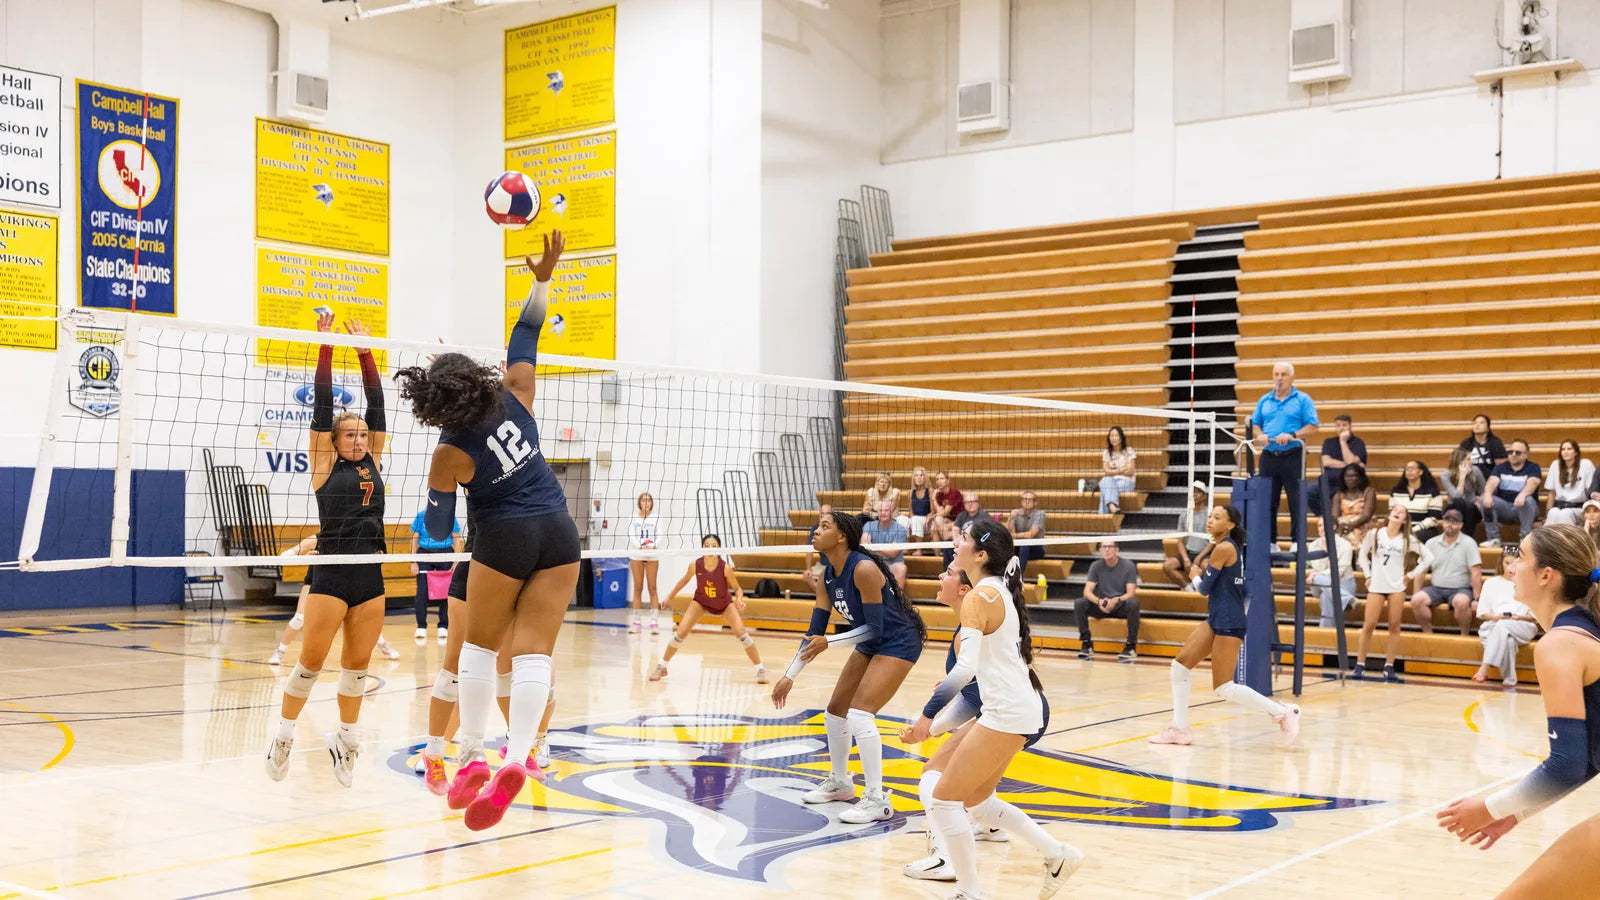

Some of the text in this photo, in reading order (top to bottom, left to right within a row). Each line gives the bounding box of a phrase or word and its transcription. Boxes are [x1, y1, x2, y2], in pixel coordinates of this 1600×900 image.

[2, 73, 31, 91] Hall
[0, 94, 43, 111] etball
[91, 91, 142, 115] Campbell
[0, 121, 48, 138] sion IV
[91, 116, 166, 142] Boy's Basktball
[262, 124, 383, 154] CAMPBELL HALL VIKINGS
[0, 142, 43, 158] gional
[292, 140, 357, 160] GIRLS TENNIS
[294, 152, 311, 162] CIF
[335, 160, 356, 171] 2004
[261, 157, 306, 172] DIVISION
[329, 170, 384, 187] CHAMPIONS
[91, 210, 168, 235] CIF Divison IV
[92, 232, 165, 254] 2005 Caliornia
[86, 255, 115, 279] State
[266, 253, 380, 275] CAMPBELL HALL VIKINGS
[281, 266, 365, 284] BOYS BASKETBALL
[291, 278, 306, 287] CIF
[262, 286, 304, 298] DIVISION
[332, 294, 384, 307] CHAMPIONS
[88, 355, 111, 381] CIF
[267, 369, 283, 380] CIF
[486, 420, 533, 473] 12
[360, 481, 374, 506] 7
[641, 529, 649, 538] 11
[1383, 554, 1391, 566] 7
[703, 586, 717, 598] 16
